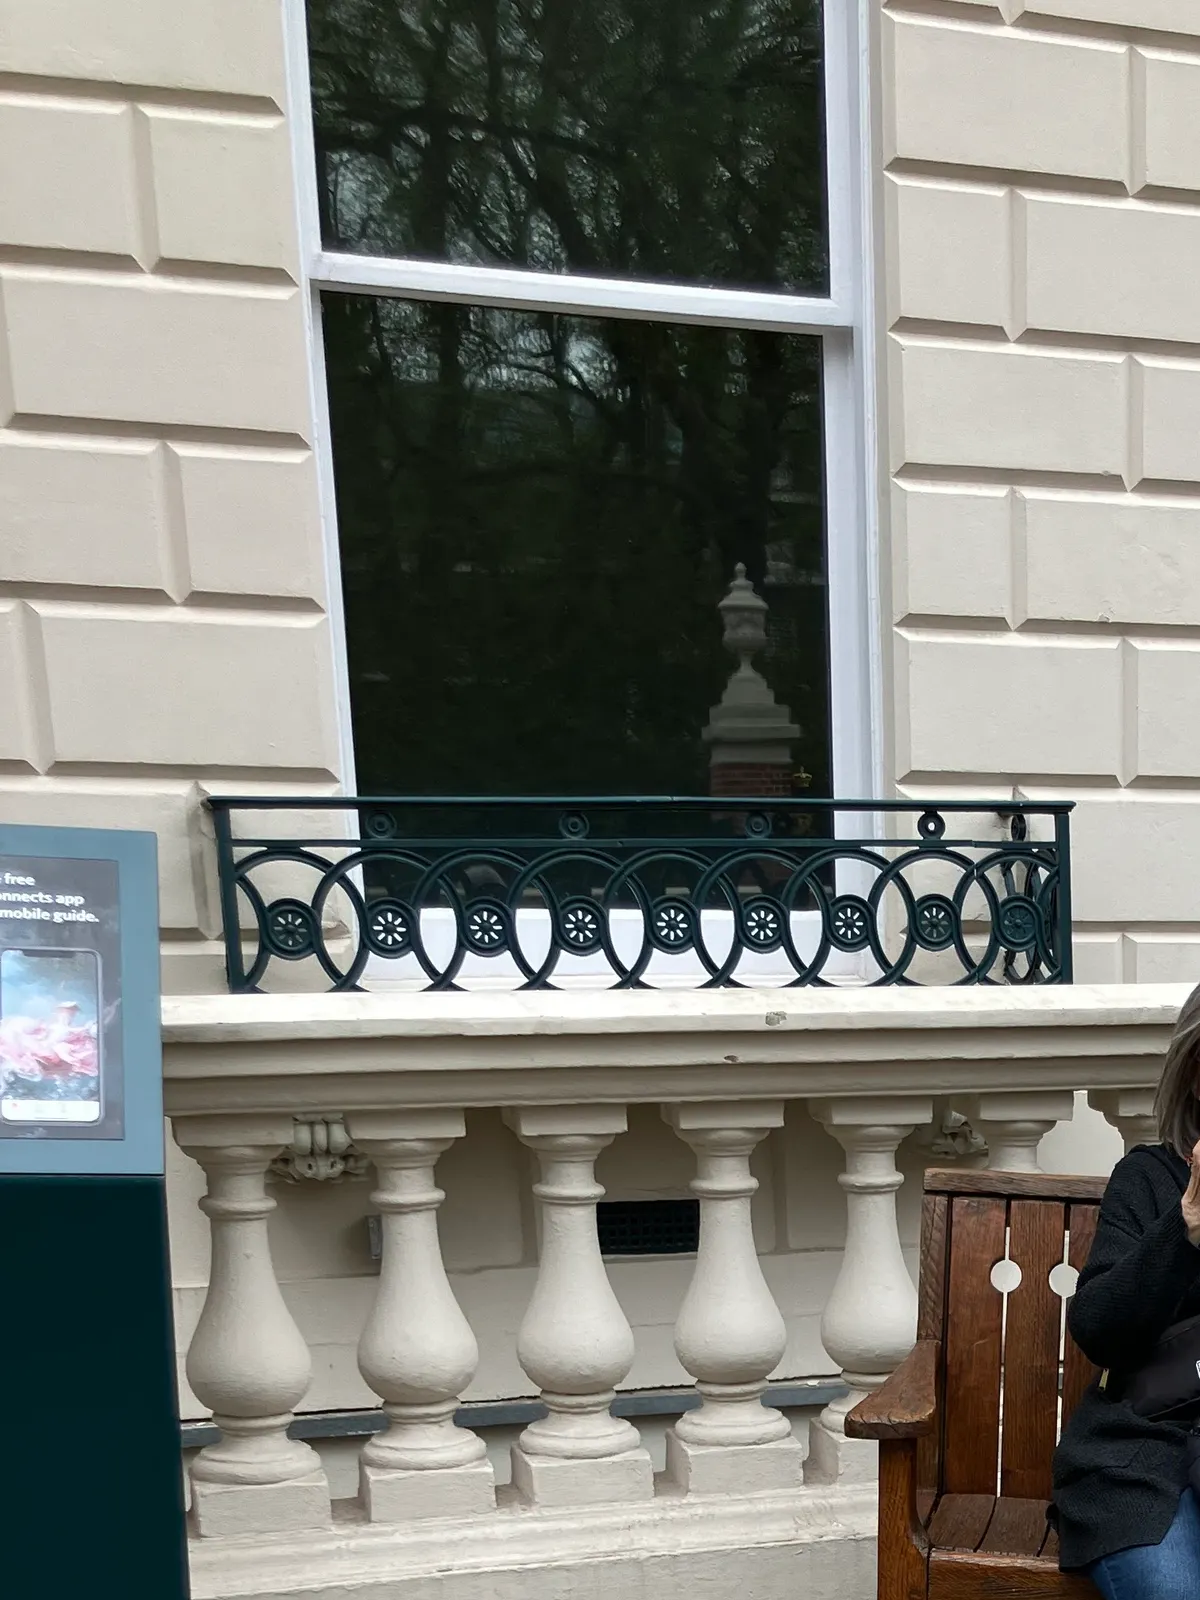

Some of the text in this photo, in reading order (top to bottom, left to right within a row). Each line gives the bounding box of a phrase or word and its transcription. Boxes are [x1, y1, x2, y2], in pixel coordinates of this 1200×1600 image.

[4, 872, 36, 885] free
[0, 892, 85, 907] nnects app
[0, 907, 99, 923] mobile guide.
